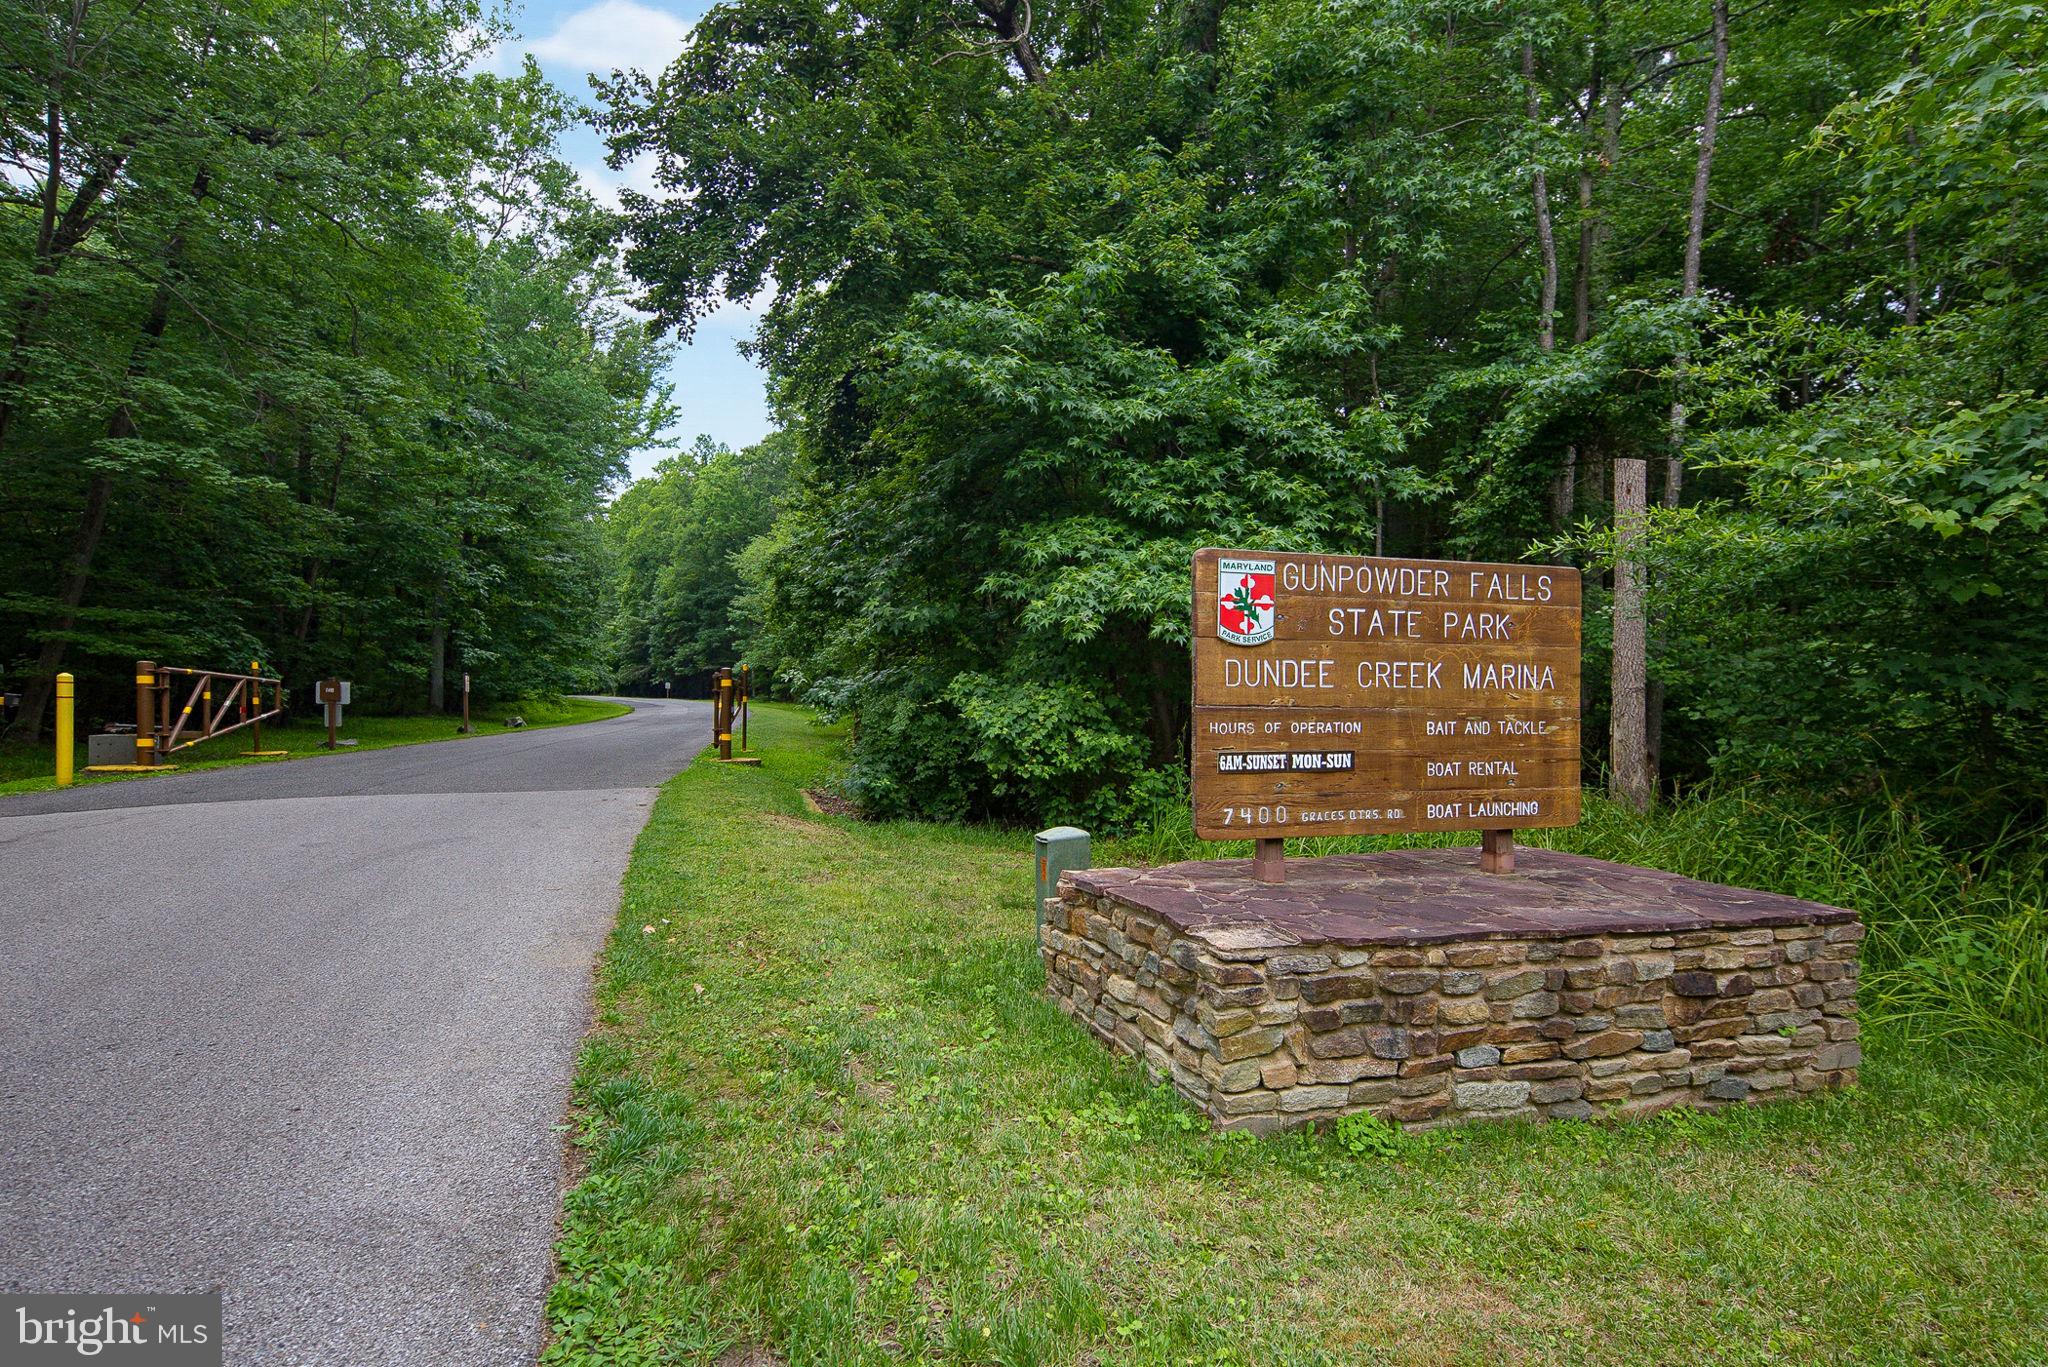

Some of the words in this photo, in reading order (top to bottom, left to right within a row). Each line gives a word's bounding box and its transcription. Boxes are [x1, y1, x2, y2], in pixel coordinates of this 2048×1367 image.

[1222, 562, 1273, 571] MARYLAND
[1283, 562, 1449, 597] GUNPOWDER
[1471, 572, 1552, 602] FALLS
[1329, 608, 1422, 638] STATE
[1444, 612, 1511, 639] PARK
[1222, 630, 1241, 642] PARK
[1242, 632, 1272, 643] SERVICE
[1225, 659, 1334, 688] DUNDEE
[1358, 662, 1442, 689] CREEK
[1463, 662, 1555, 689] MARINA
[1209, 722, 1254, 734] HOURS
[1265, 722, 1281, 734] OF
[1291, 722, 1361, 734] OPERATION
[1427, 721, 1456, 736] BAIT
[1464, 721, 1490, 735] AND
[1498, 721, 1546, 734] TACKLE
[1220, 754, 1287, 770] 6AM-SUNSET
[1292, 753, 1351, 768] MON-SUN
[1427, 762, 1461, 776] BOAT
[1469, 761, 1518, 775] RENTAL
[1302, 810, 1344, 822] GRACES
[1427, 803, 1462, 818] BOAT
[1469, 801, 1538, 817] LAUNCHING
